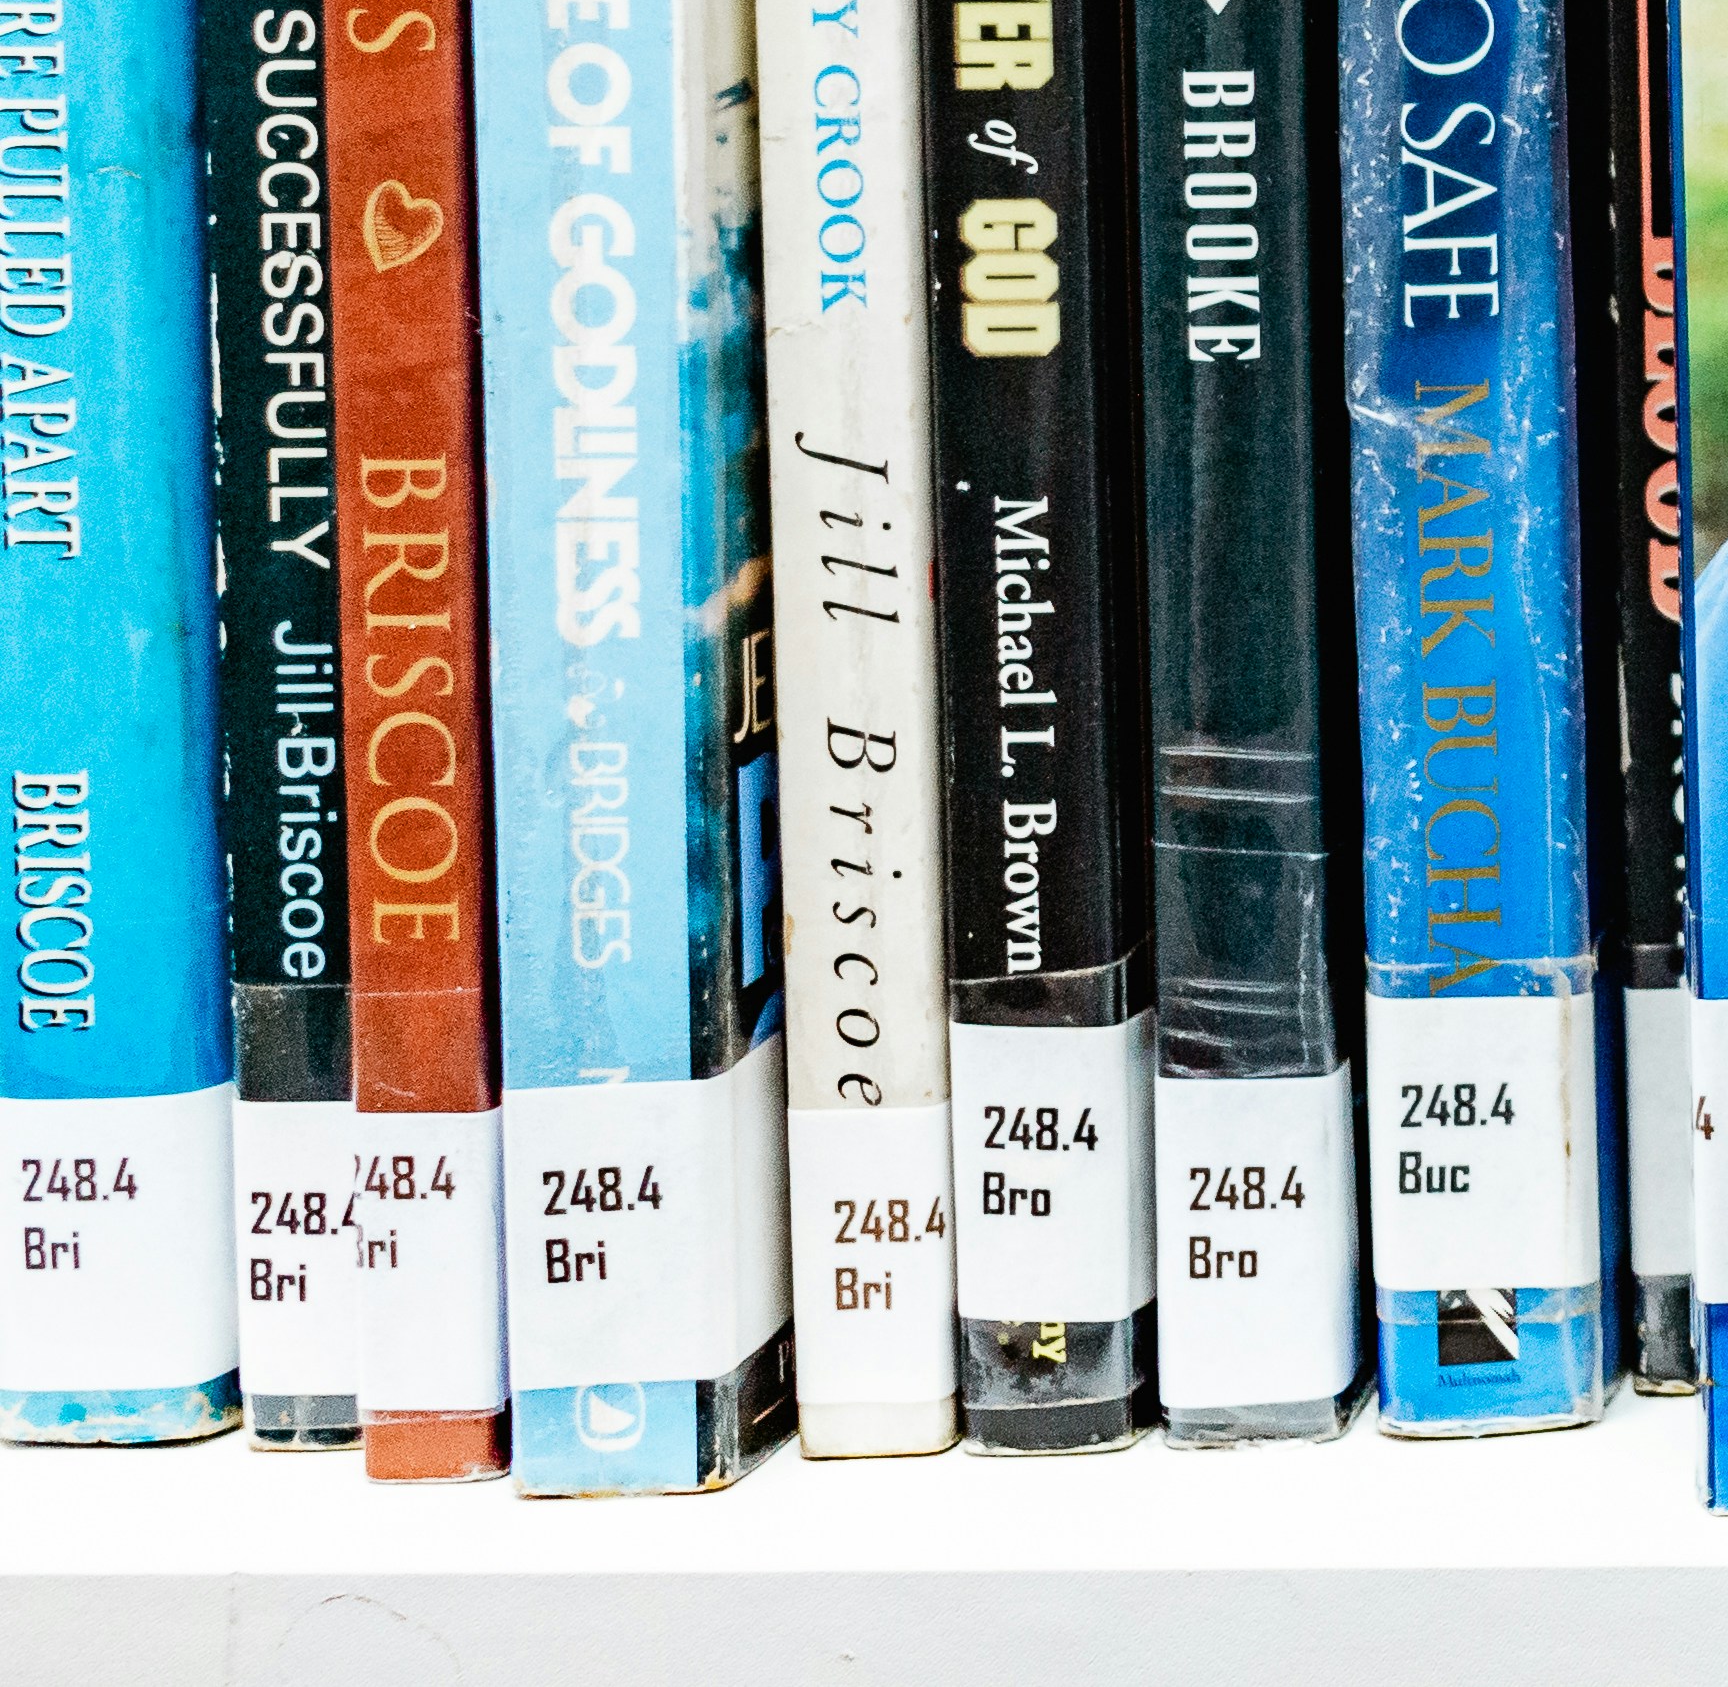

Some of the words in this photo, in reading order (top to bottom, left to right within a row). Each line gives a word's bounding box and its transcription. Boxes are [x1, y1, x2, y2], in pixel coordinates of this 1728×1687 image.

[547, 43, 633, 174] OF
[969, 119, 1038, 174] of
[0, 92, 72, 338] PULLED
[814, 64, 868, 314] CROOK
[1182, 69, 1261, 362] BROOKE
[1401, 101, 1501, 329] SAFE
[253, 9, 330, 569] SUCCESSFULLY
[959, 198, 1061, 358] GOD
[0, 359, 80, 559] APART
[549, 194, 641, 646] GODLINESS
[794, 431, 901, 624] Jill
[1414, 379, 1497, 655] MARK
[994, 496, 1055, 709] Michael
[359, 453, 461, 945] BRISCOE
[1002, 725, 1054, 778] L.
[11, 771, 95, 1034] BRISCOE
[277, 736, 335, 977] Briscoe
[570, 743, 631, 969] BRIDGES
[826, 716, 902, 1106] Briscoe
[1004, 798, 1057, 972] Brown
[983, 1106, 1098, 1153] 248.4
[1400, 1082, 1514, 1129] 248.4
[21, 1158, 138, 1204] 248.4
[354, 1154, 456, 1200] 48.4
[542, 1165, 663, 1215] 248.4
[833, 1194, 947, 1244] 248.4
[983, 1174, 1051, 1218] Bro
[1189, 1166, 1306, 1213] 248.4
[1400, 1151, 1470, 1195] Buc
[23, 1226, 81, 1271] Bri
[250, 1258, 307, 1301] Bri
[355, 1225, 398, 1268] ri
[545, 1238, 607, 1284] Bri
[835, 1269, 893, 1311] Bri
[1189, 1237, 1257, 1280] Bro
